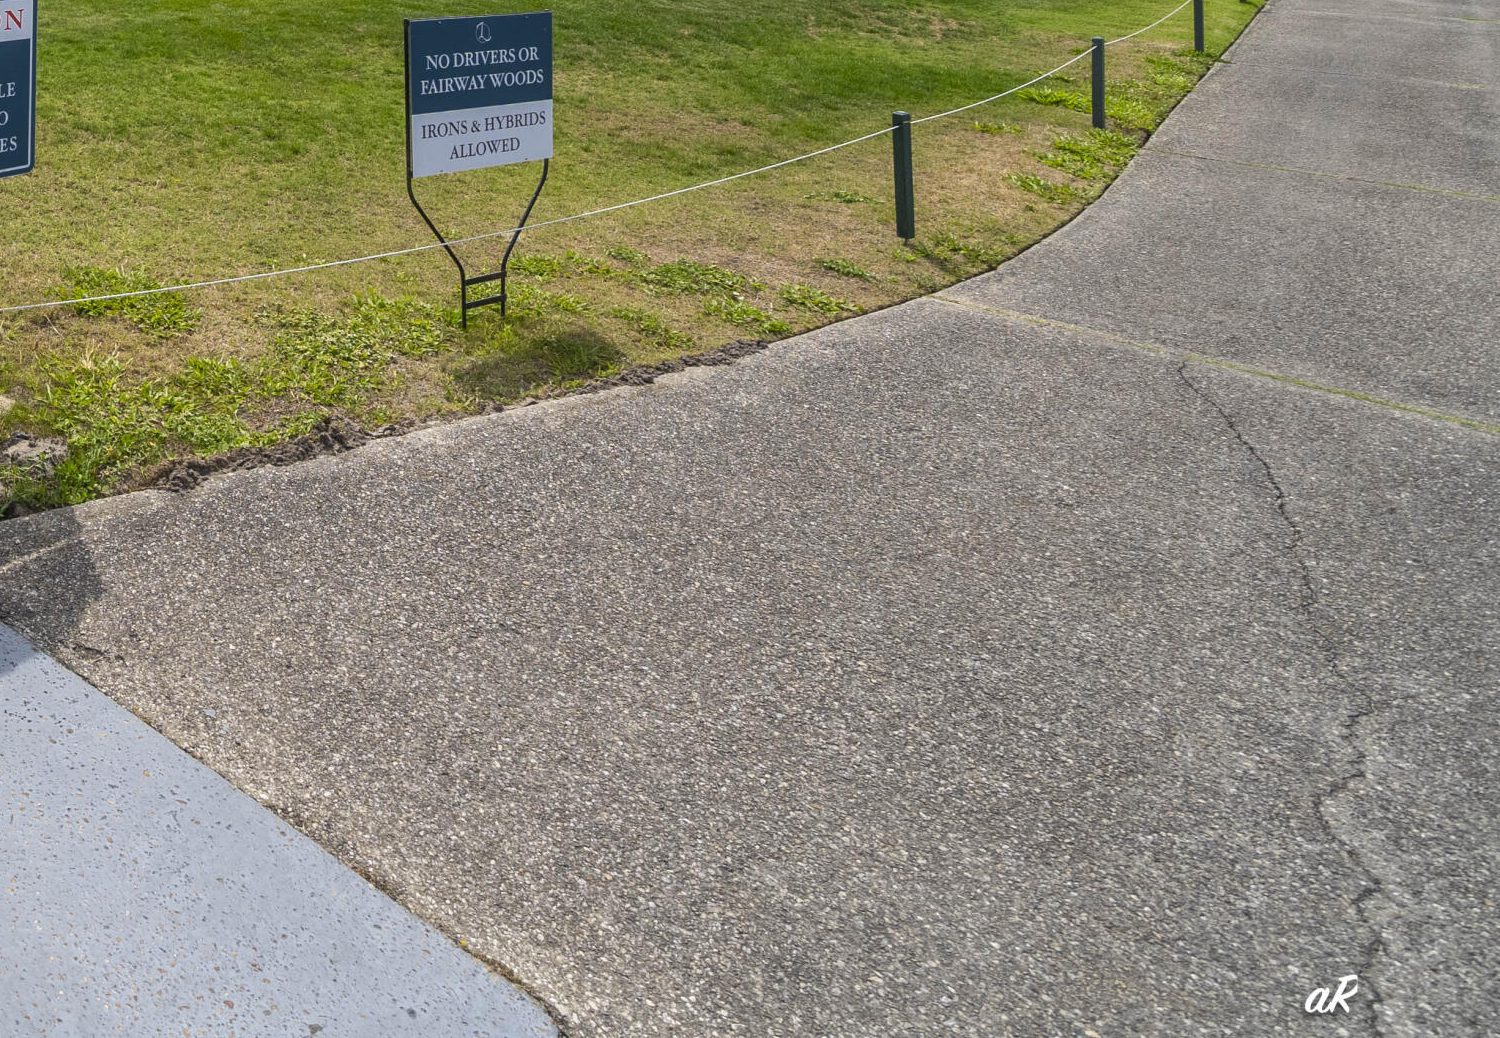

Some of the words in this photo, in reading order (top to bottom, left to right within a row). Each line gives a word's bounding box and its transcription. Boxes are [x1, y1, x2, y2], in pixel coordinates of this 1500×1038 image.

[425, 54, 450, 70] NO
[453, 48, 516, 68] DRIVERS
[518, 46, 539, 62] OR
[420, 73, 489, 95] FAIRWAY
[489, 69, 544, 88] WOODS
[421, 120, 468, 140] IRONS
[471, 120, 481, 133] &
[484, 111, 546, 132] HYBRIDS
[450, 137, 520, 160] ALLOWED
